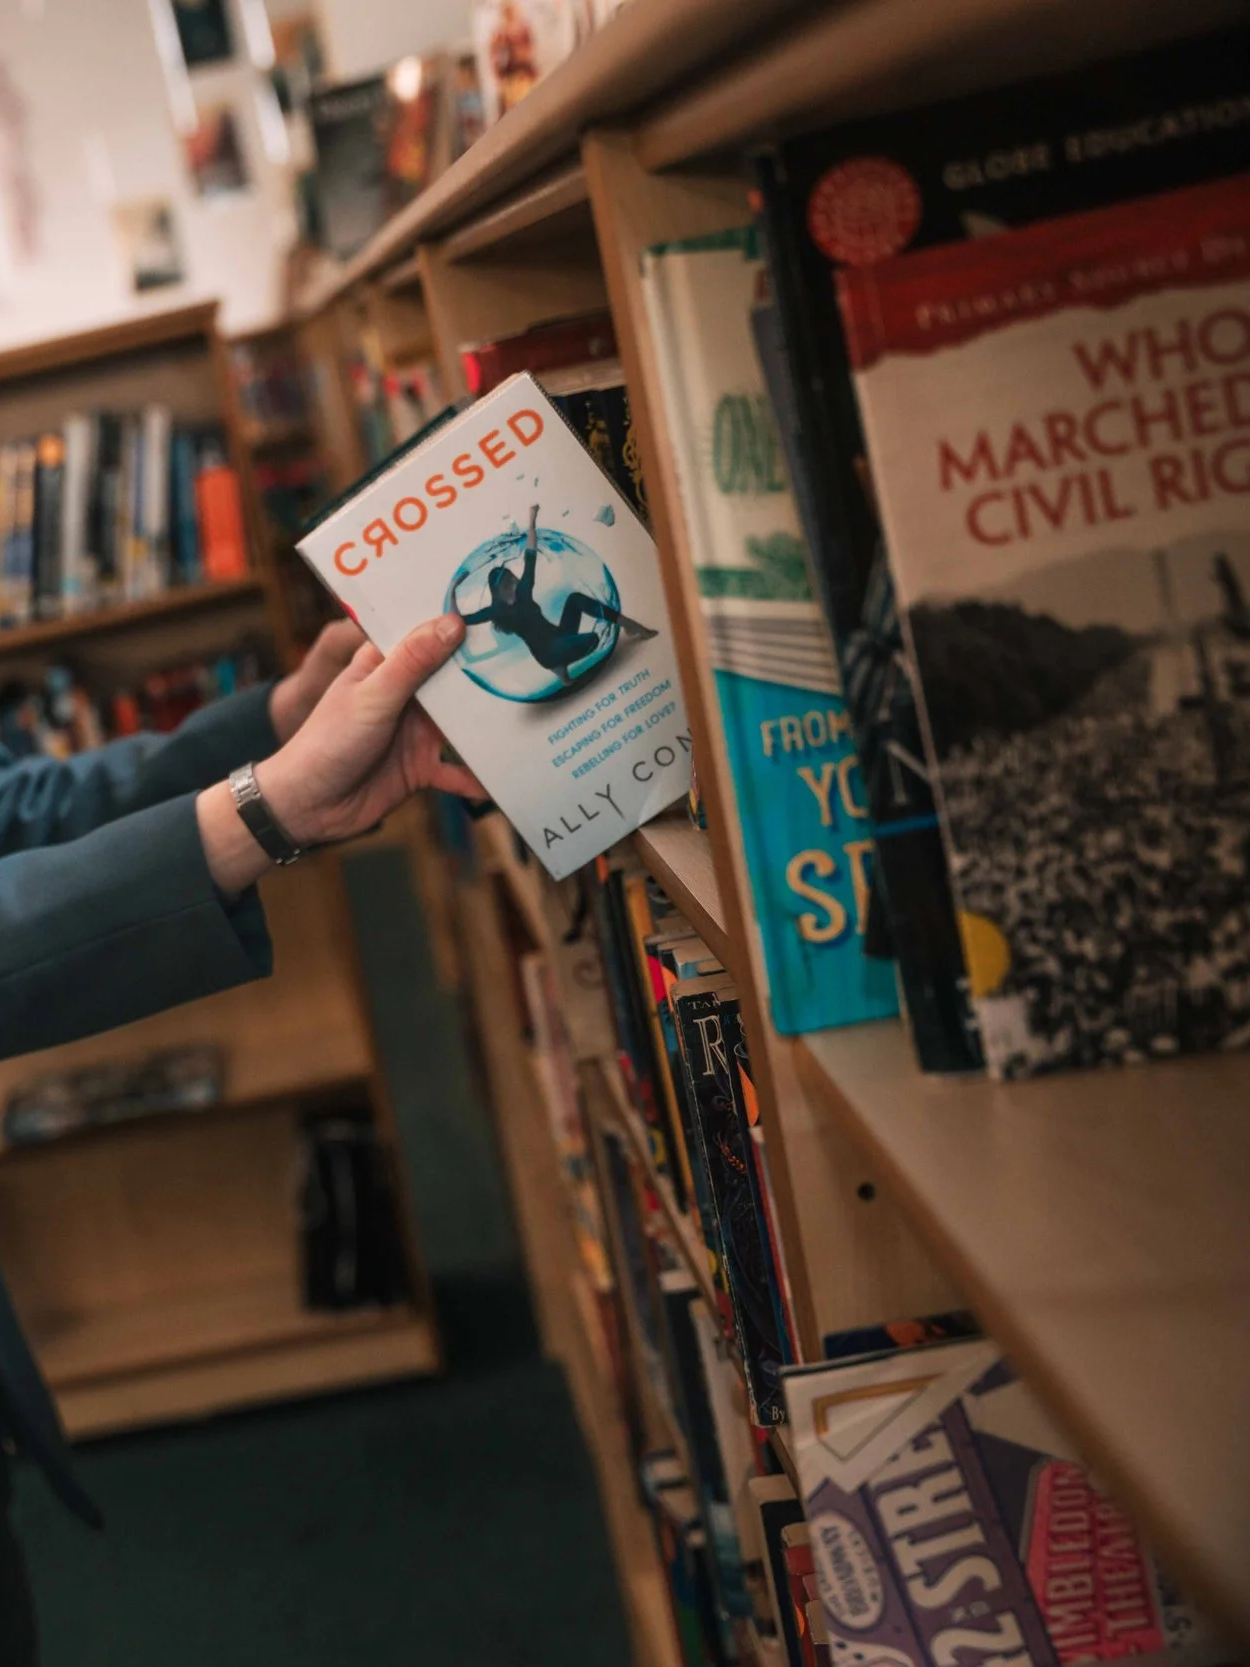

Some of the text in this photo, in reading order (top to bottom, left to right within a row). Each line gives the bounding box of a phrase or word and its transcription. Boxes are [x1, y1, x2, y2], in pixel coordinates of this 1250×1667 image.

[1070, 306, 1250, 393] WHO
[333, 408, 545, 576] CROSSED
[965, 467, 1138, 548] CIVIL
[548, 669, 651, 744] FIGHTING FOR TRUTH
[552, 679, 671, 768] ESCAPING FOR FREEDOM
[760, 709, 855, 757] FROM
[572, 740, 623, 779] REBELLING
[622, 725, 645, 744] FOR
[543, 783, 627, 849] ALLY
